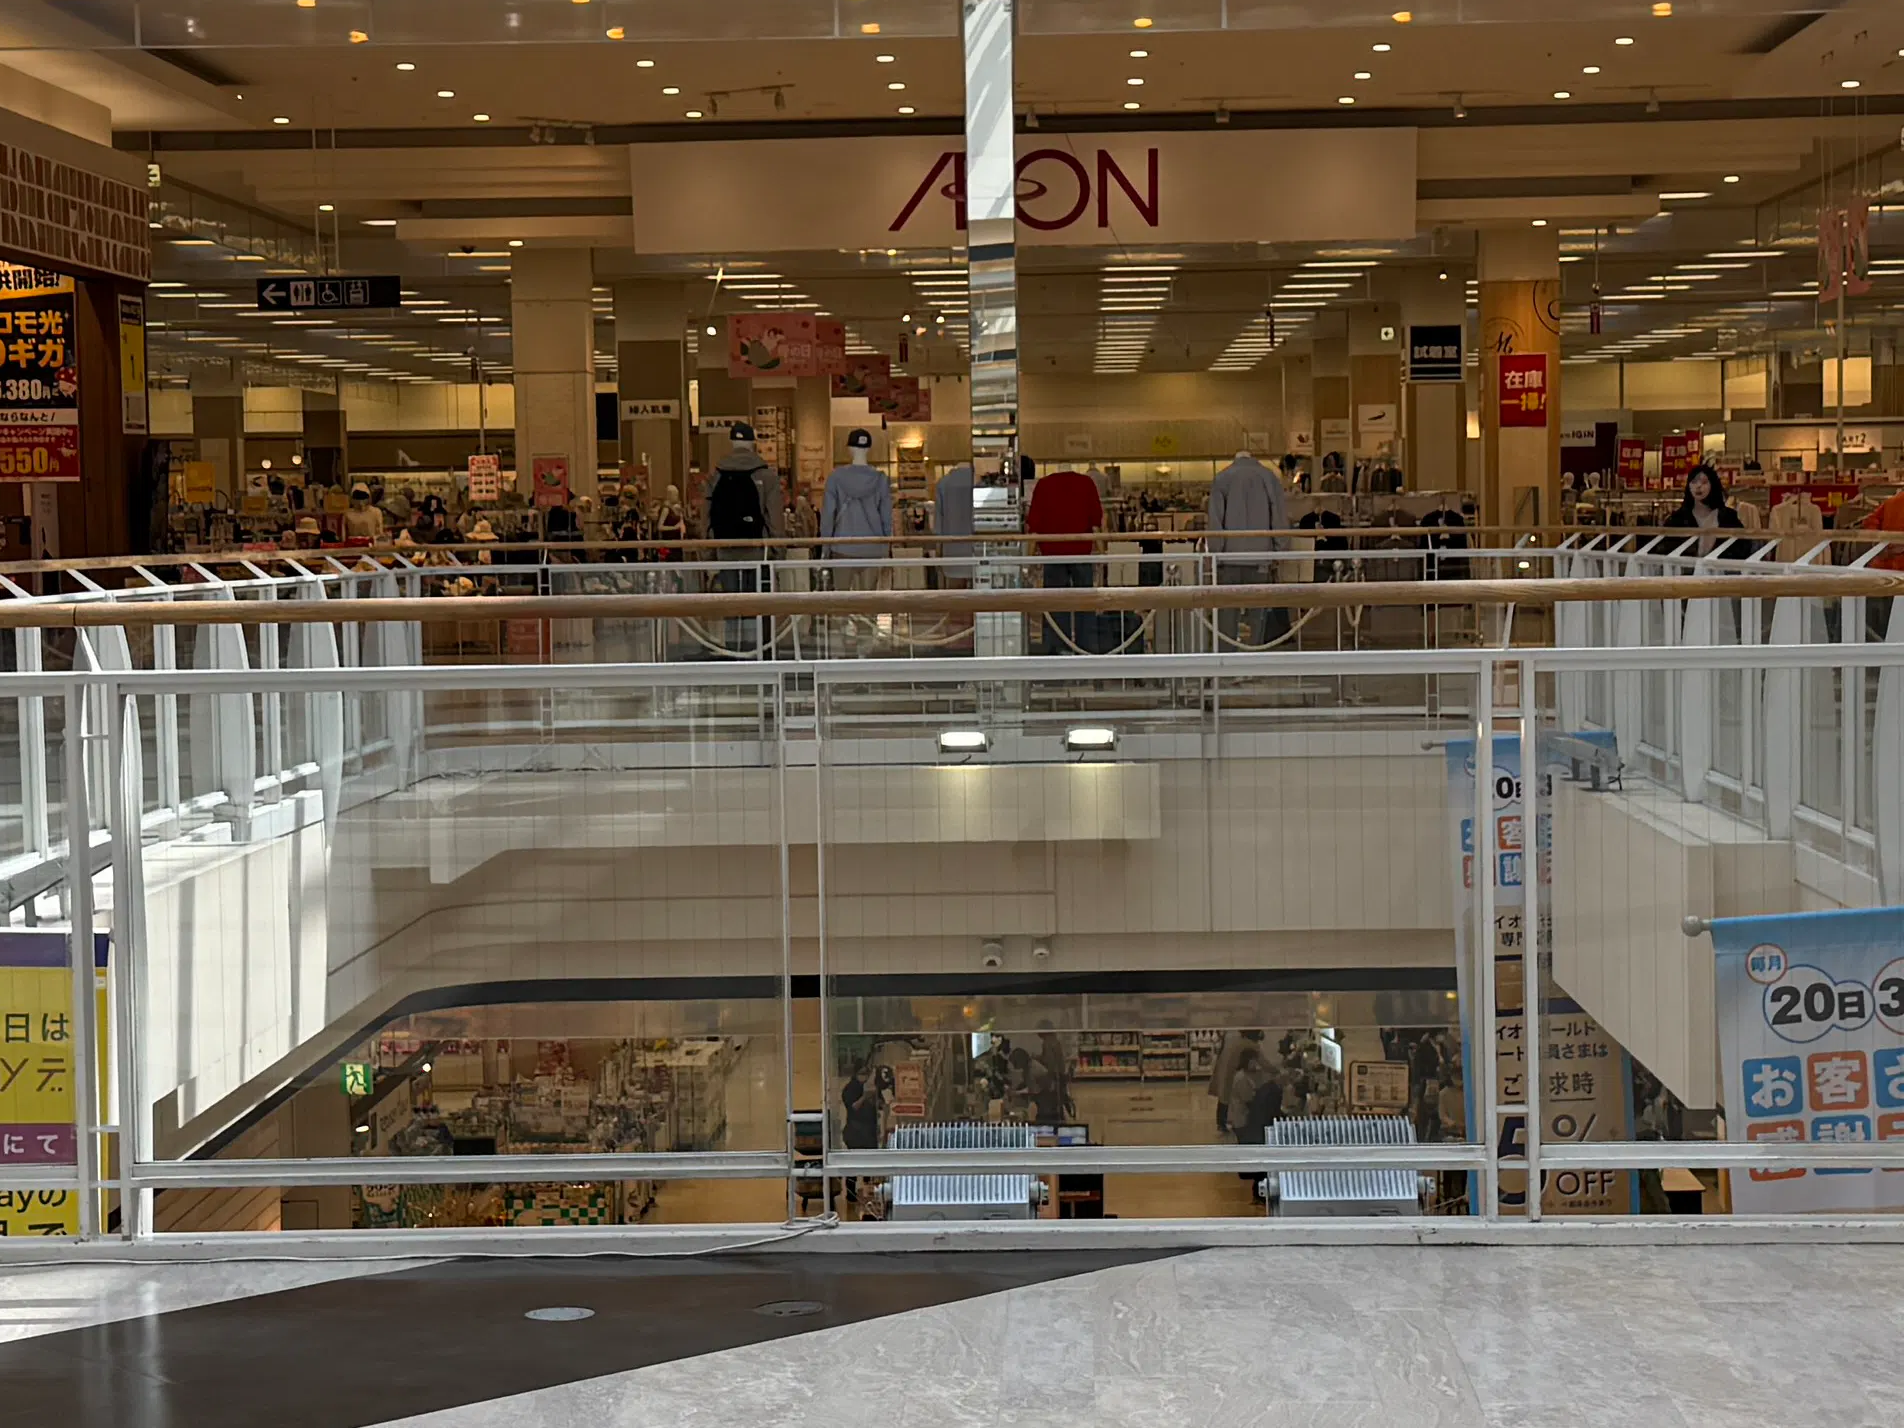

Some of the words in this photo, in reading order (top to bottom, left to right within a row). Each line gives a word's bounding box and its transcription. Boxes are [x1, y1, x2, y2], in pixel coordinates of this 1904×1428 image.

[888, 148, 1158, 232] AON
[1504, 370, 1545, 390] 在庫
[1750, 955, 1783, 973] 毎月
[1770, 982, 1866, 1025] 20日
[1556, 1171, 1615, 1197] OFF
